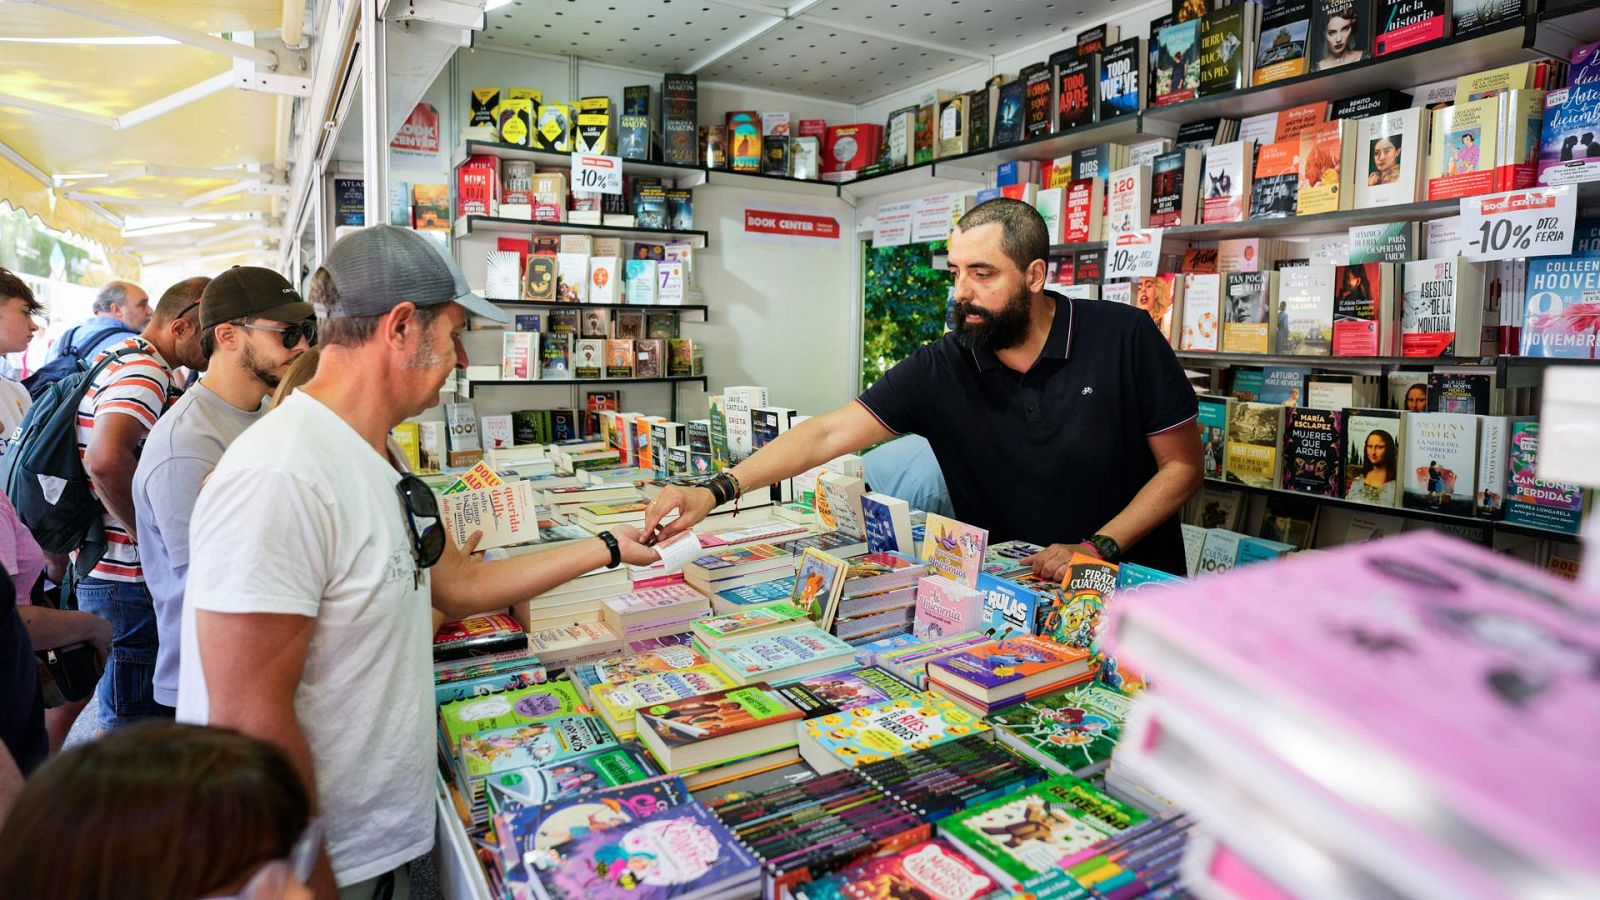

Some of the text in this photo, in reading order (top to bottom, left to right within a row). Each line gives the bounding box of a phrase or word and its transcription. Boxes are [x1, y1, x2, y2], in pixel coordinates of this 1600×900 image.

[1327, 3, 1353, 15] MALDITA
[1399, 0, 1424, 15] de la
[1201, 20, 1210, 32] LA
[1388, 9, 1434, 31] historia
[1201, 33, 1225, 49] TIERRA
[1200, 50, 1222, 66] BAJO
[1106, 58, 1131, 79] TODO
[1200, 65, 1229, 82] TUS PIES
[668, 83, 695, 91] MARTIN
[1063, 73, 1085, 92] TODO
[1100, 70, 1139, 102] VUELVE
[1059, 86, 1089, 113] ARDE
[1350, 97, 1371, 107] BENITO
[1033, 111, 1044, 121] YO
[1338, 101, 1381, 116] PÉREZ GALDÓS
[621, 120, 648, 129] MARTIN
[1550, 107, 1600, 127] diciemb
[667, 123, 695, 132] MARTIN
[1080, 159, 1098, 174] DIOS
[576, 167, 606, 189] -10%
[1113, 177, 1135, 194] 120
[1483, 196, 1548, 211] BOOK CENTER
[747, 216, 777, 229] BOOK
[778, 219, 814, 231] CENTER
[1536, 217, 1558, 231] DTO.
[1388, 233, 1407, 244] PARÍS
[1469, 218, 1533, 254] -10%
[1535, 230, 1565, 243] FERIA
[1366, 243, 1407, 255] DESPERTABA
[1385, 251, 1406, 261] TARDE
[1108, 249, 1139, 273] -10%
[1547, 261, 1600, 273] COLLEEN
[1444, 262, 1453, 279] EL
[1230, 273, 1266, 284] TAN POCA
[1534, 272, 1600, 291] HOOVE
[1246, 282, 1267, 293] VIDA
[1421, 280, 1453, 299] ASESINO
[1432, 298, 1451, 315] DE LA
[1418, 316, 1452, 333] MONTAÑA
[1270, 371, 1300, 381] ARTURO
[1265, 379, 1304, 389] PÉREZ-REVERTE
[1294, 421, 1332, 431] ESCLAPEZ
[1299, 414, 1325, 423] MARÍA
[1292, 430, 1333, 442] MUJERES
[1295, 447, 1327, 459] ARDEN
[1301, 440, 1320, 451] QUE
[1512, 474, 1580, 492] CANCIONES
[1516, 486, 1573, 503] PERDIDAS
[491, 489, 505, 520] dolly
[503, 487, 521, 534] querida
[1514, 502, 1571, 517] ANDREA LONGARELA
